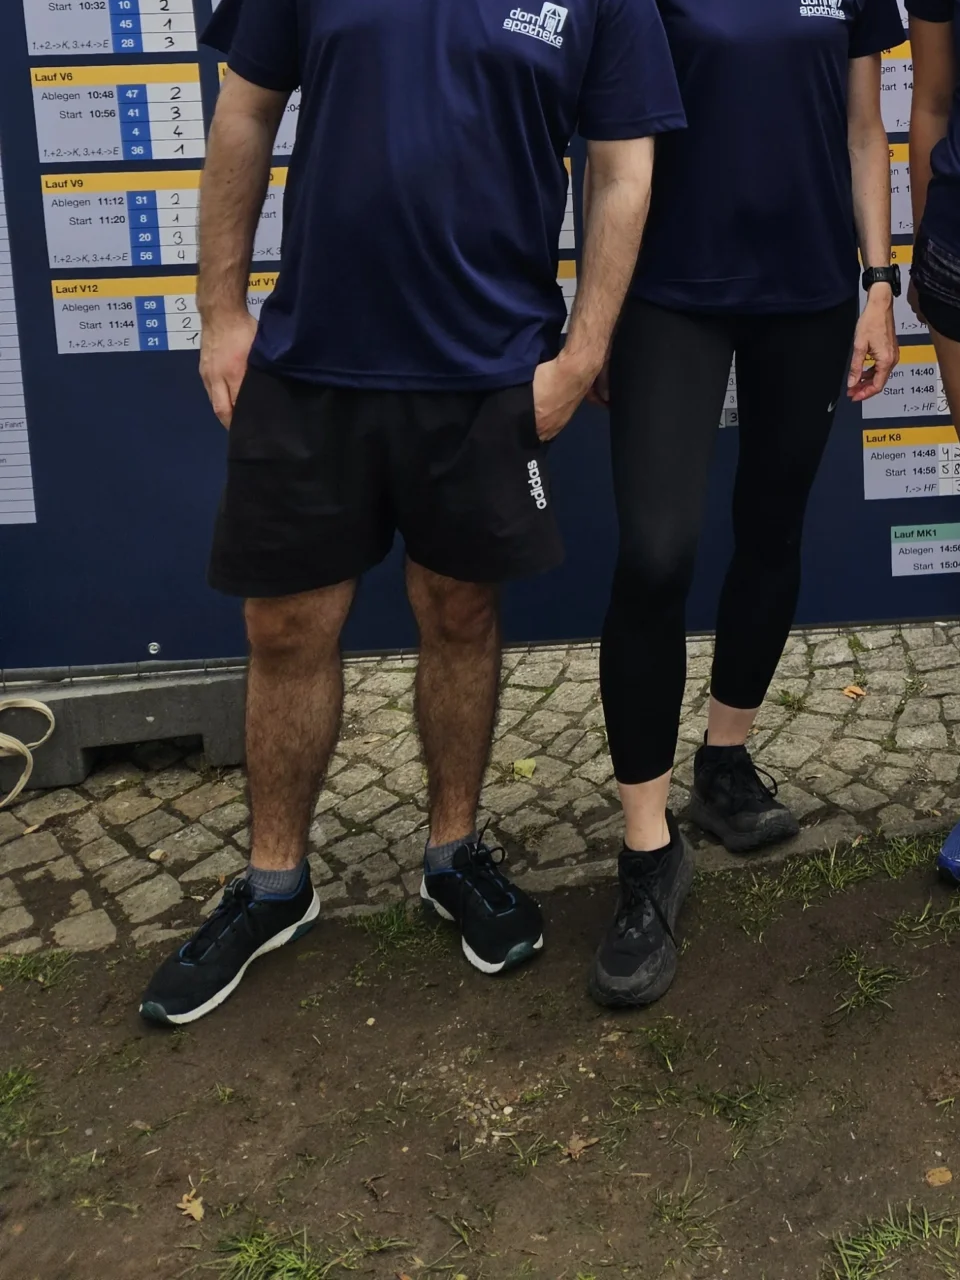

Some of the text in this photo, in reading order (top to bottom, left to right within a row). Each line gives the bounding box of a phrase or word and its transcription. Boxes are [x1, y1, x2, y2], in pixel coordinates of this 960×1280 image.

[509, 7, 541, 25] dom
[800, 5, 845, 19] apotheke
[504, 18, 563, 47] apotheke
[55, 284, 99, 295] Lauf V12
[866, 434, 902, 443] Lauf K8
[870, 449, 936, 460] Ablegen 14:48
[885, 466, 936, 477] Start 14:56
[527, 460, 547, 510] adidas
[894, 528, 937, 539] Lauf MK1
